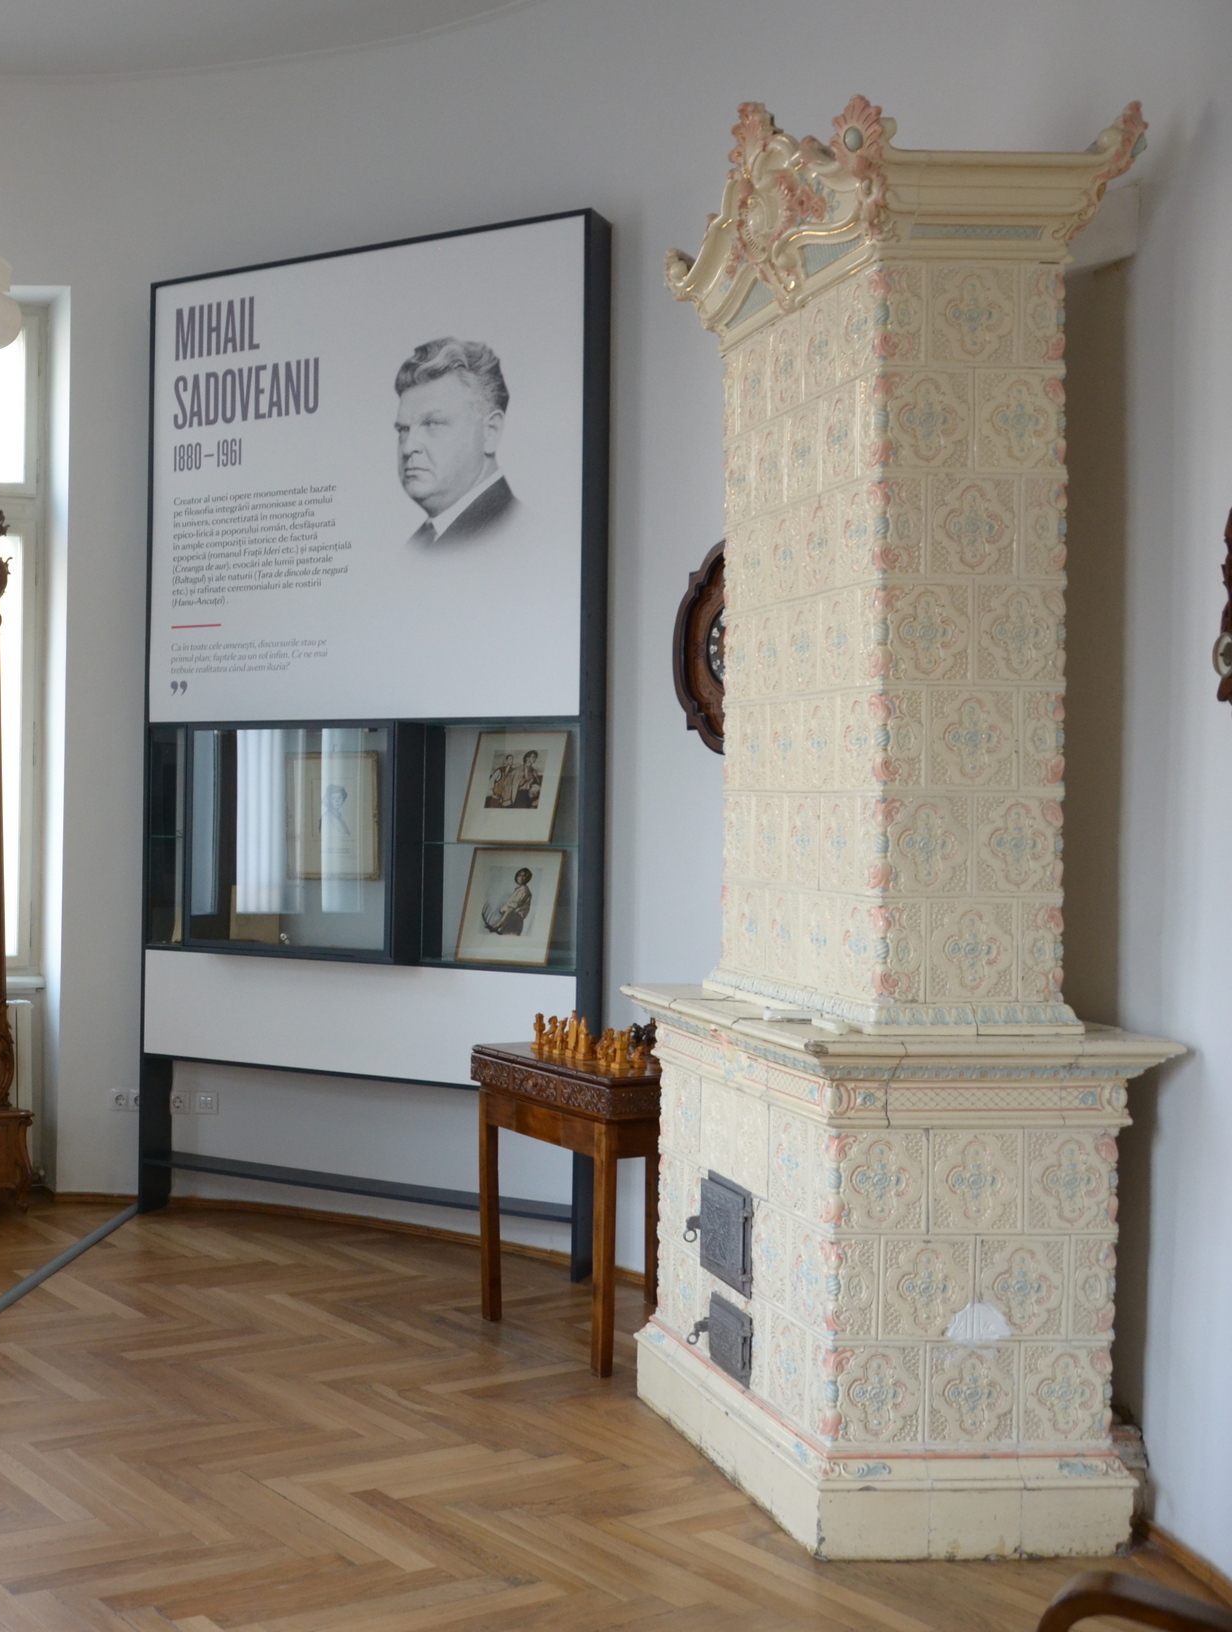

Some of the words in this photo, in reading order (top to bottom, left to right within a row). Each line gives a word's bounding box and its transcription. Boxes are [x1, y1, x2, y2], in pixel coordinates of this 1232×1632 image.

[175, 296, 260, 361] MIHAIL
[173, 357, 320, 430] SADOVEANU
[173, 495, 202, 506] Creator
[204, 495, 210, 503] al
[211, 493, 228, 502] unei
[229, 493, 252, 503] opere
[253, 485, 308, 499] monumentale
[310, 482, 336, 493] bazate
[174, 511, 183, 519] pe
[184, 505, 214, 516] filosofia
[215, 502, 250, 515] integrării
[251, 498, 297, 510] armonioase
[304, 494, 333, 505] omului
[173, 520, 181, 528] în
[182, 517, 210, 528] univers,
[211, 513, 259, 525] concretizată
[260, 512, 268, 521] în
[269, 508, 315, 522] monografia
[173, 528, 214, 541] epico-lirică
[221, 524, 259, 537] poporului
[260, 522, 288, 533] român,
[289, 518, 336, 532] desfășurată
[173, 542, 180, 550] în
[181, 540, 204, 552] ample
[206, 537, 246, 550] compoziții
[248, 534, 277, 545] istorice
[278, 533, 288, 542] de
[290, 531, 318, 542] factură
[173, 552, 206, 564] epopeică
[208, 548, 242, 561] (romanul
[281, 545, 299, 556] etc.)
[300, 544, 307, 554] și
[308, 540, 352, 554] sapiențială
[172, 562, 204, 575] (Creanga
[205, 562, 214, 571] de
[232, 559, 260, 569] evocări
[261, 558, 273, 567] ale
[274, 556, 294, 566] lumii
[296, 554, 333, 566] pastorale
[172, 574, 206, 586] (Baltagul)
[207, 573, 214, 584] și
[215, 573, 226, 581] ale
[228, 571, 253, 581] naturii
[274, 569, 283, 578] de
[284, 567, 311, 577] dincolo
[312, 566, 322, 575] de
[321, 565, 348, 577] negură
[172, 587, 188, 597] etc.)
[190, 586, 196, 596] și
[197, 584, 226, 594] rafinate
[227, 581, 280, 592] ceremonialuri
[282, 580, 294, 589] ale
[295, 578, 321, 588] rostirii
[171, 642, 182, 652] Ca
[190, 643, 208, 651] toate
[209, 641, 222, 650] cele
[258, 638, 300, 648] discursurile
[317, 639, 327, 647] pe
[170, 653, 194, 665] primul
[212, 652, 237, 663] faptele
[258, 651, 268, 659] rol
[291, 649, 303, 658] Ce
[314, 649, 328, 657] mai
[170, 665, 195, 674] trebuie
[196, 664, 228, 673] realitatea
[229, 663, 246, 672] când
